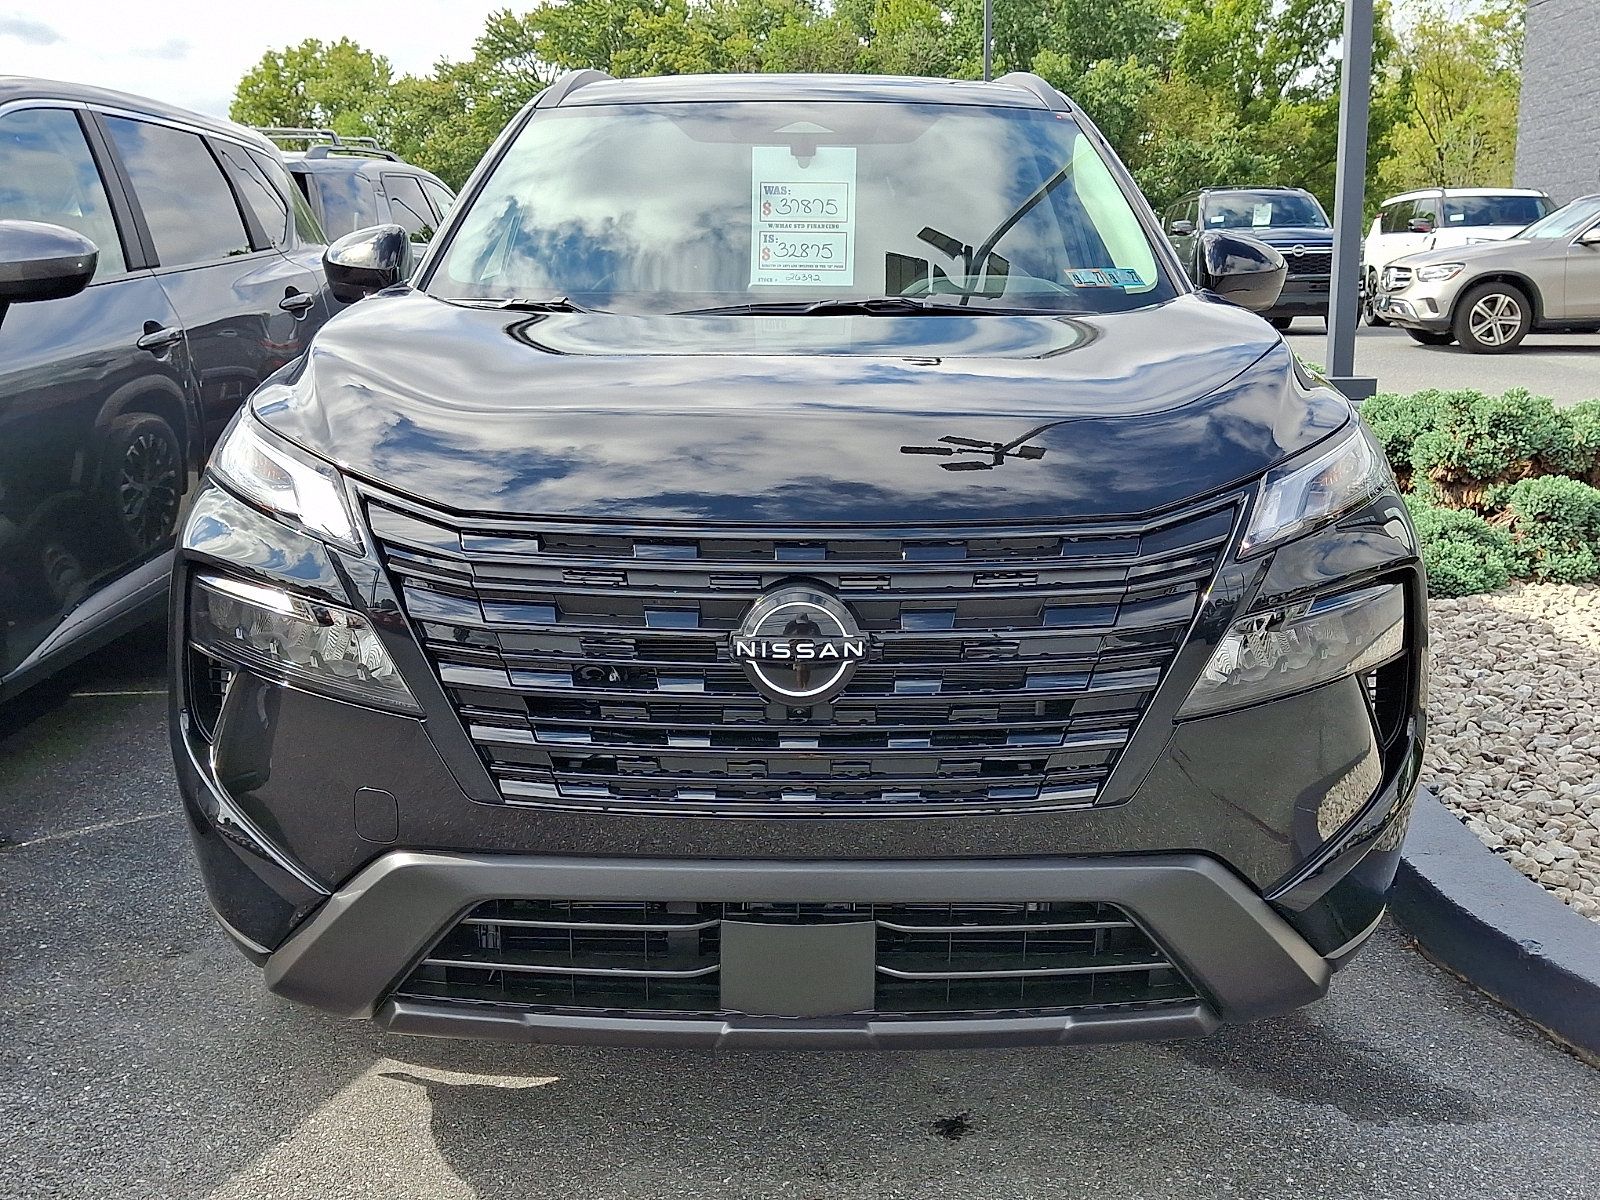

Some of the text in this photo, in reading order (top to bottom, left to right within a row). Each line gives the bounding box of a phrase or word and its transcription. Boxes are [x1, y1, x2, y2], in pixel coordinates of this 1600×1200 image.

[763, 185, 791, 195] WAS:
[762, 198, 838, 217] $ 37875
[763, 234, 779, 244] IS:
[762, 242, 833, 261] $ 32875
[785, 273, 822, 282] 26392
[736, 641, 863, 658] NISSAN
